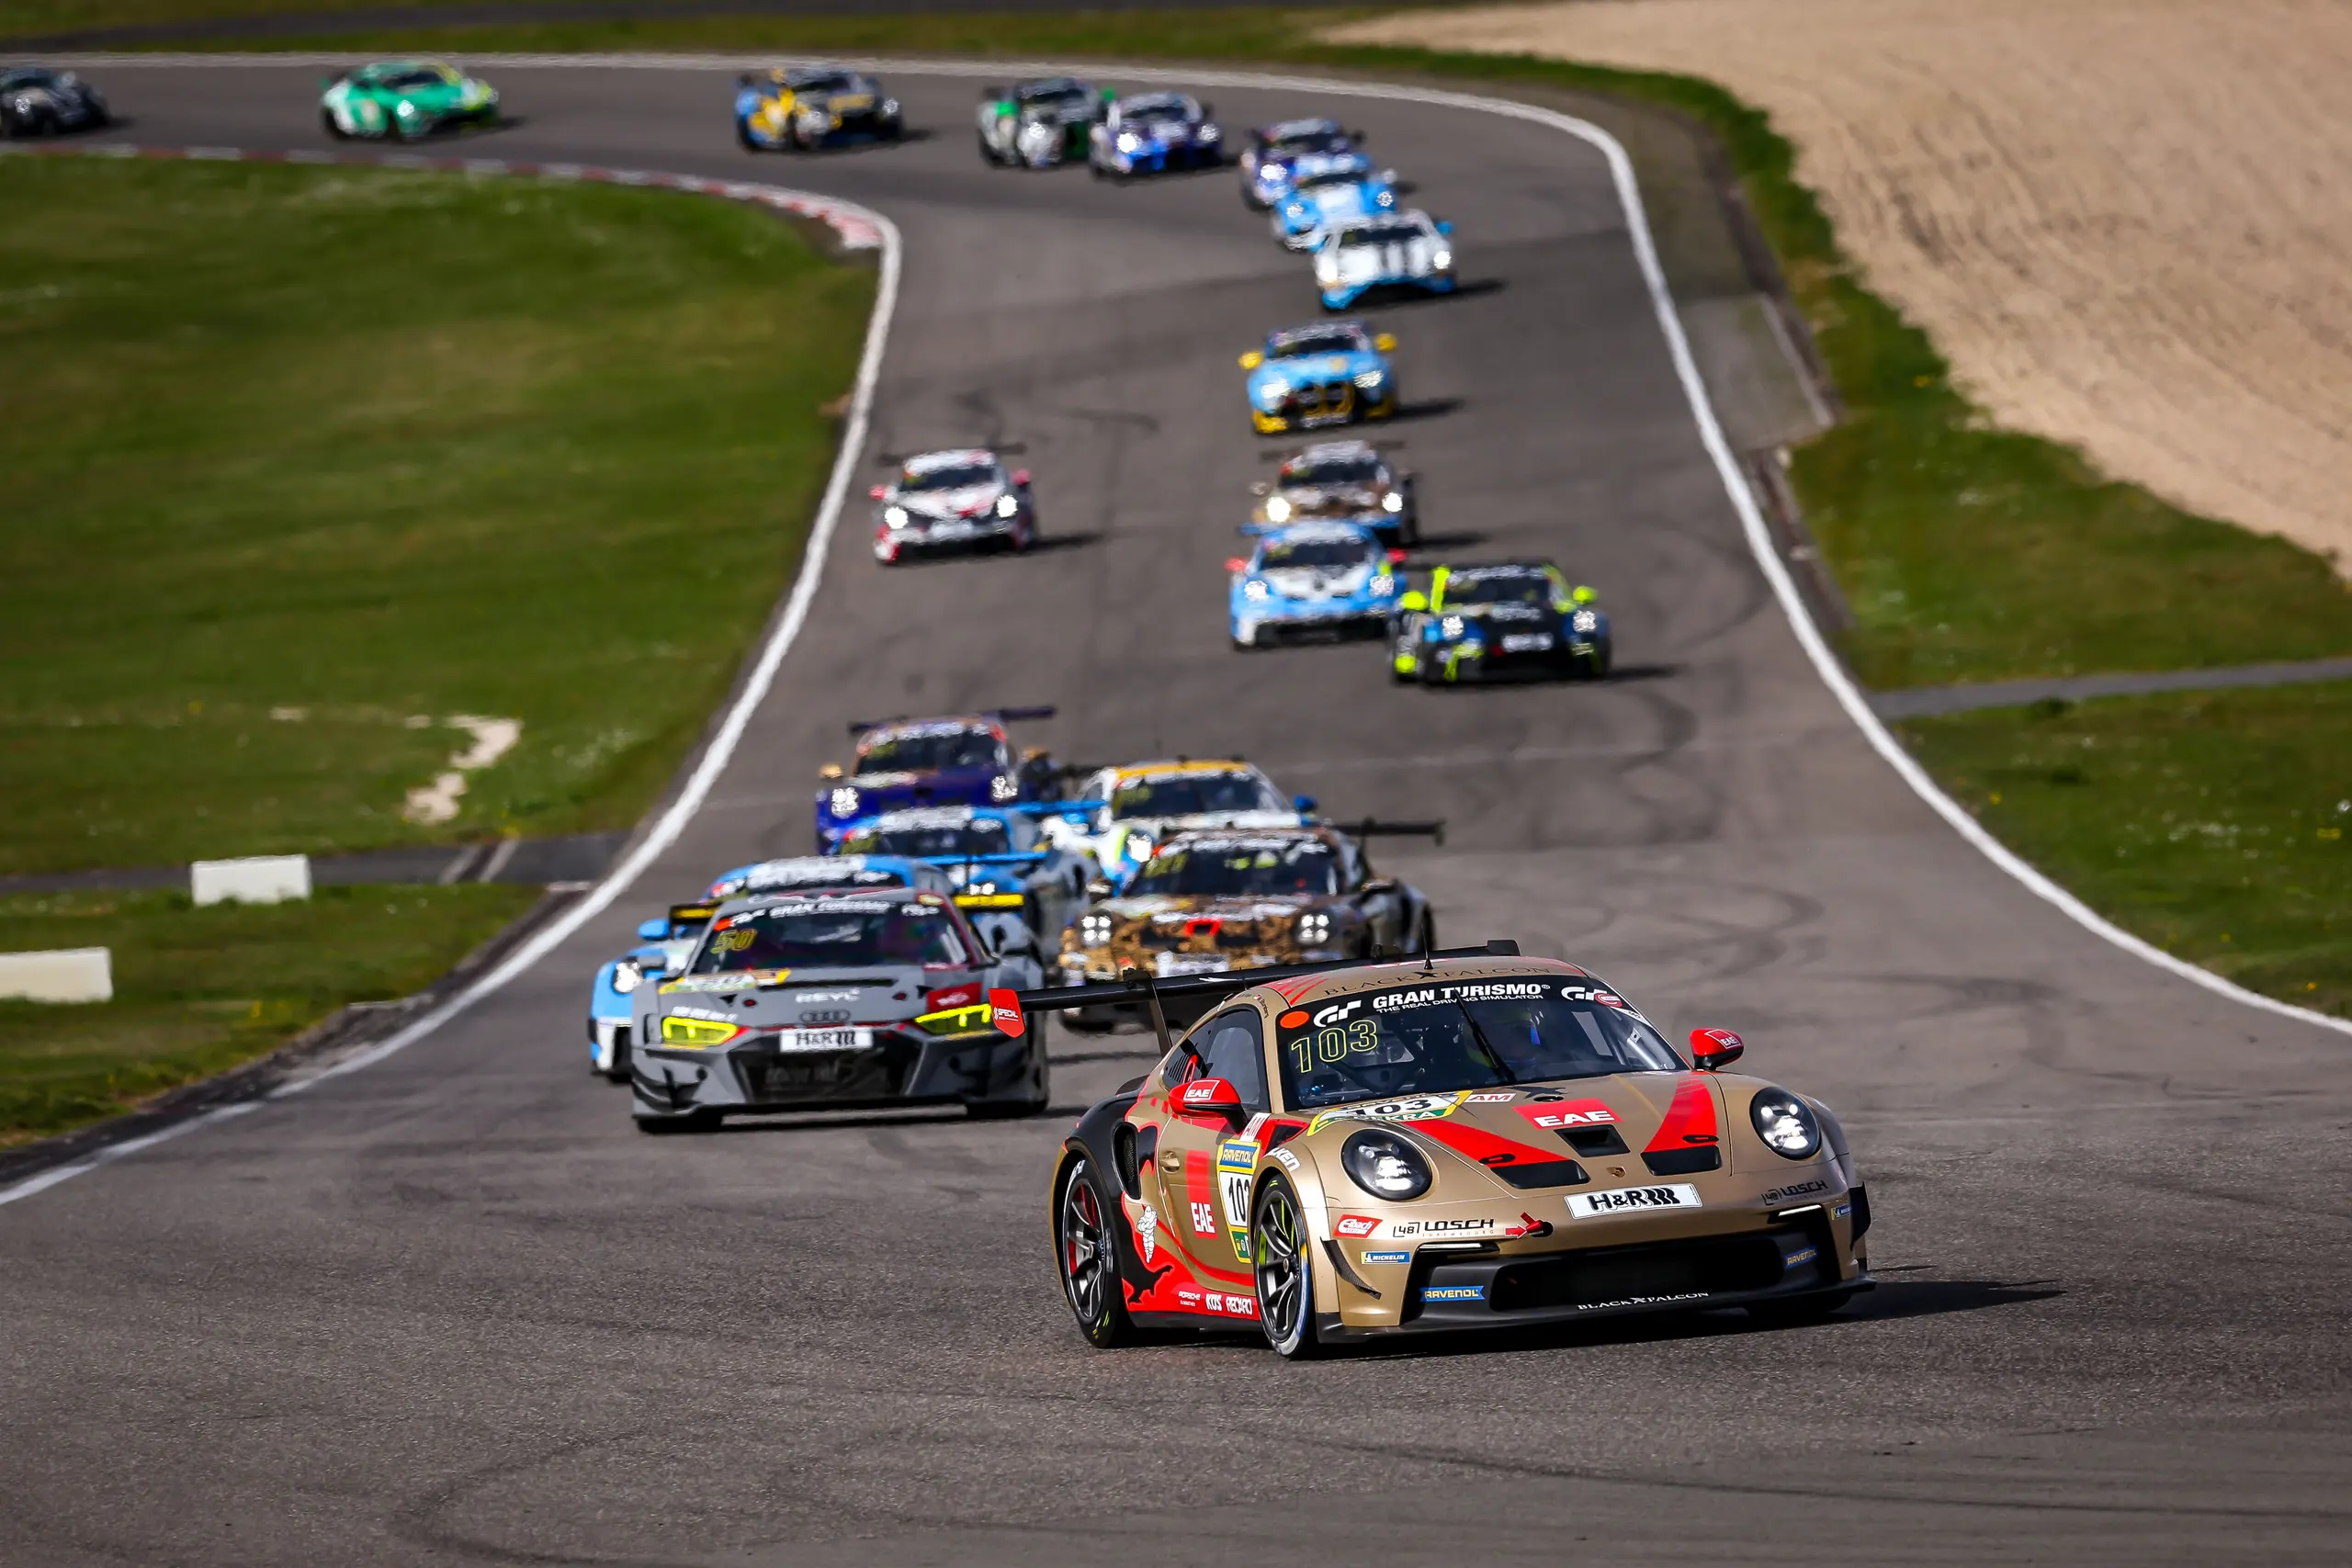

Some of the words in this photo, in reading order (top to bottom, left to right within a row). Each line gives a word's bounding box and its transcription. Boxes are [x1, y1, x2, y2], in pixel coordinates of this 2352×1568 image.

[1324, 976, 1410, 997] BLACK
[1444, 966, 1551, 977] FALCON
[1372, 988, 1435, 1010] GRAN
[1376, 1005, 1400, 1015] THE
[1402, 1001, 1431, 1010] REAL
[1432, 996, 1477, 1008] DRIVNG
[1477, 994, 1544, 1003] SIMULATOR
[1291, 1019, 1378, 1074] 103
[1720, 1036, 1738, 1046] EAE
[1186, 1089, 1211, 1098] EAE
[1346, 1100, 1431, 1116] 103
[1532, 1110, 1615, 1128] EAE
[1222, 1148, 1254, 1164] RAVENOL
[1781, 1179, 1828, 1196] LOSCH
[1191, 1201, 1216, 1234] EAE
[1424, 1219, 1495, 1231] LOSCH
[1372, 1253, 1406, 1261] MICHELIN
[1424, 1289, 1479, 1299] RAVENOL
[1577, 1300, 1633, 1310] BLACK
[1646, 1292, 1710, 1303] FALCON
